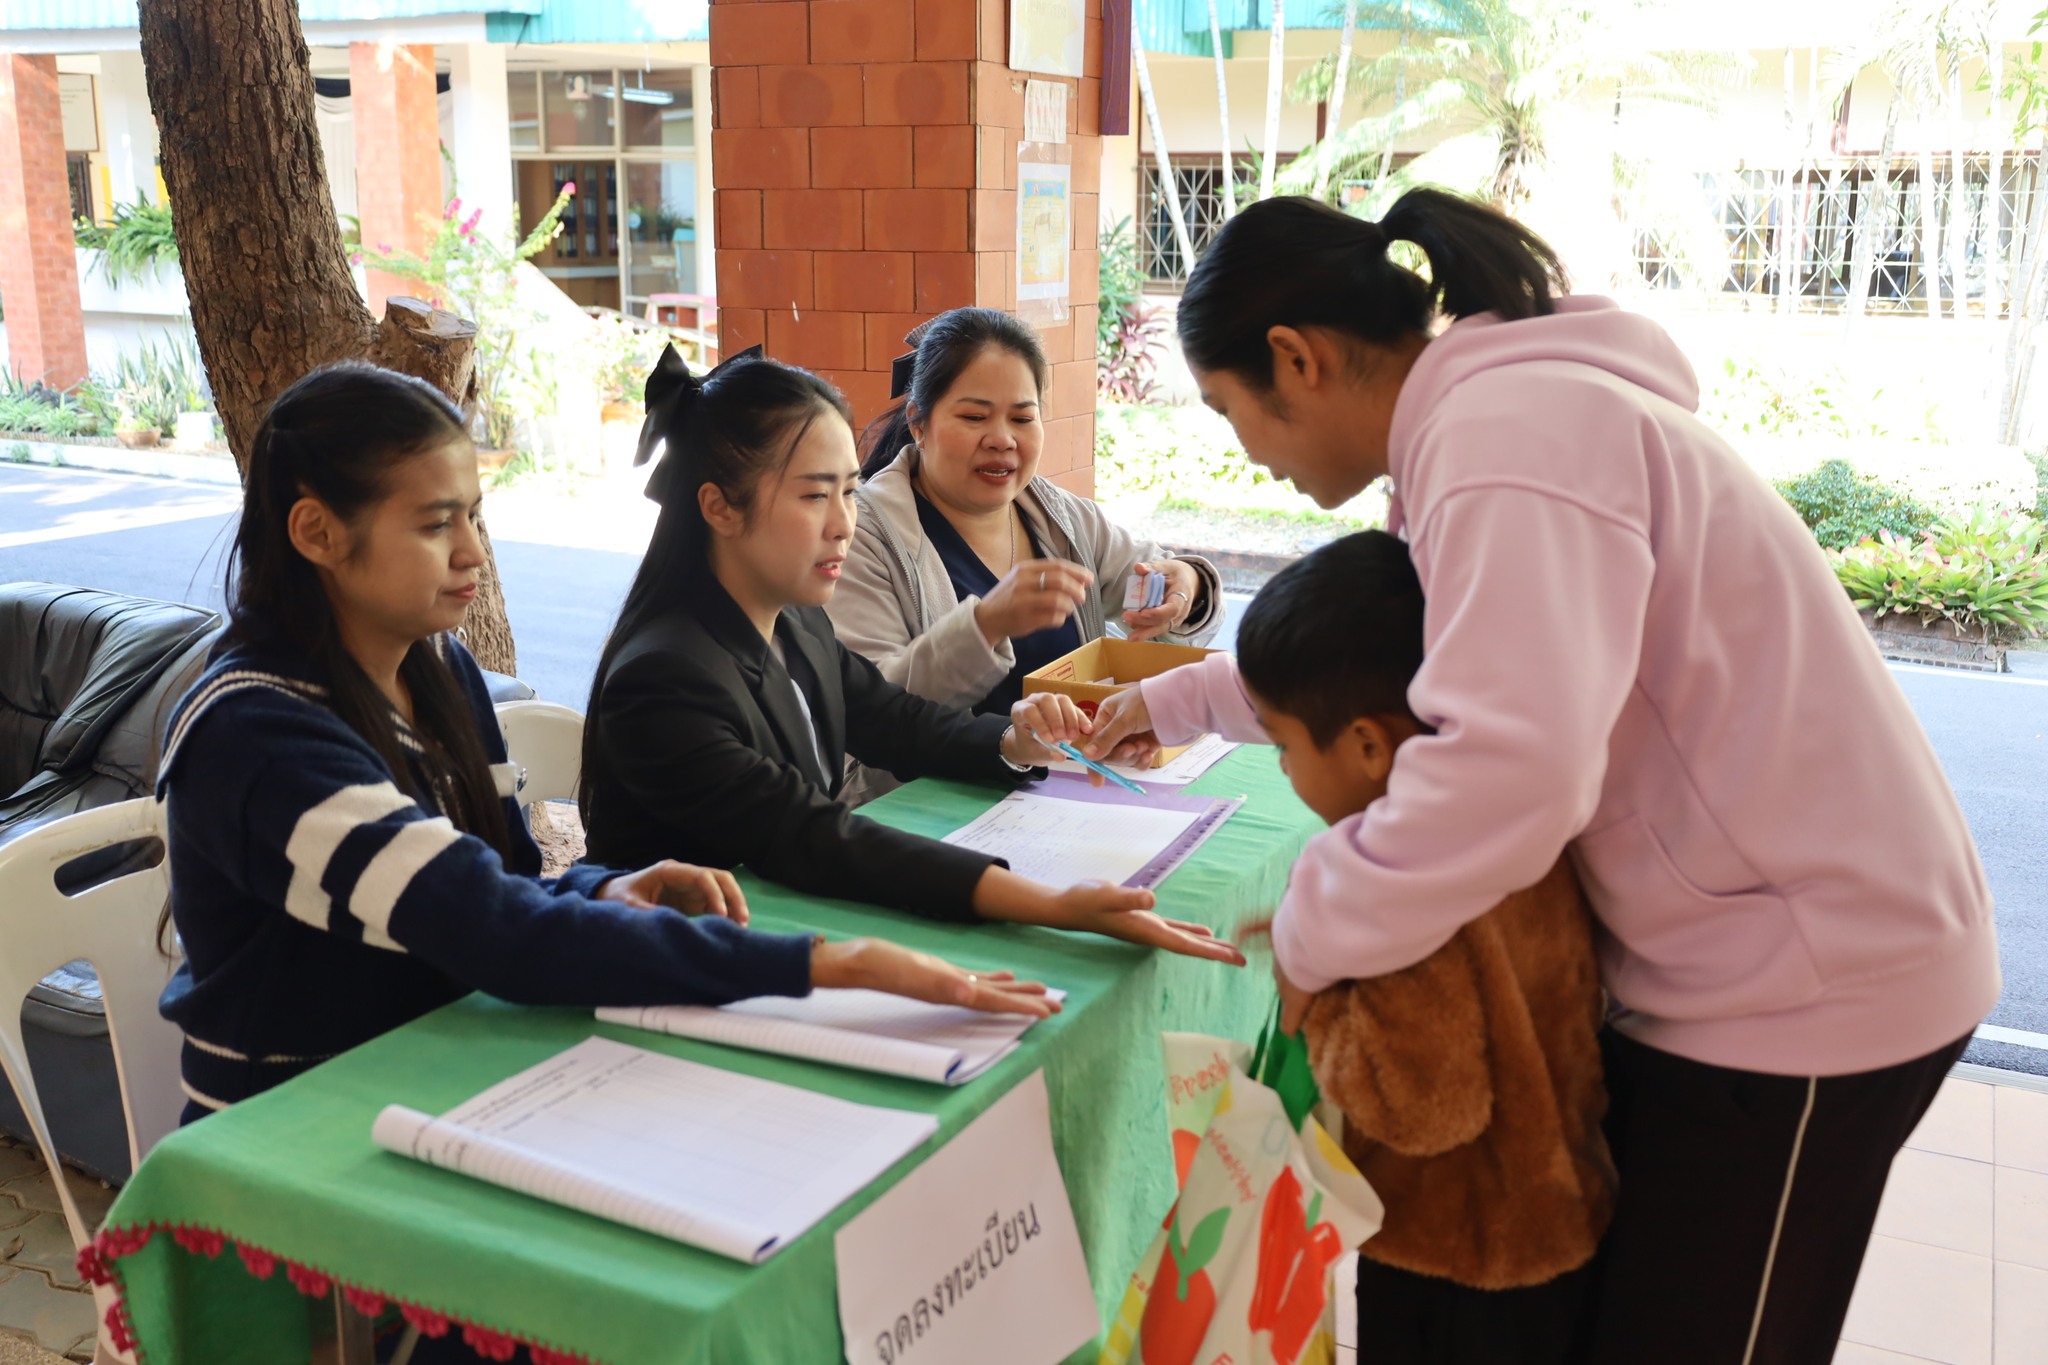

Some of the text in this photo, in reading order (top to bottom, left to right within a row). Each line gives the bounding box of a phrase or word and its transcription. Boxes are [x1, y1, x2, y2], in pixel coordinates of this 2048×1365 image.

[1169, 1051, 1229, 1106] Fresh
[874, 1202, 1041, 1365] จดลงทะเบียน
